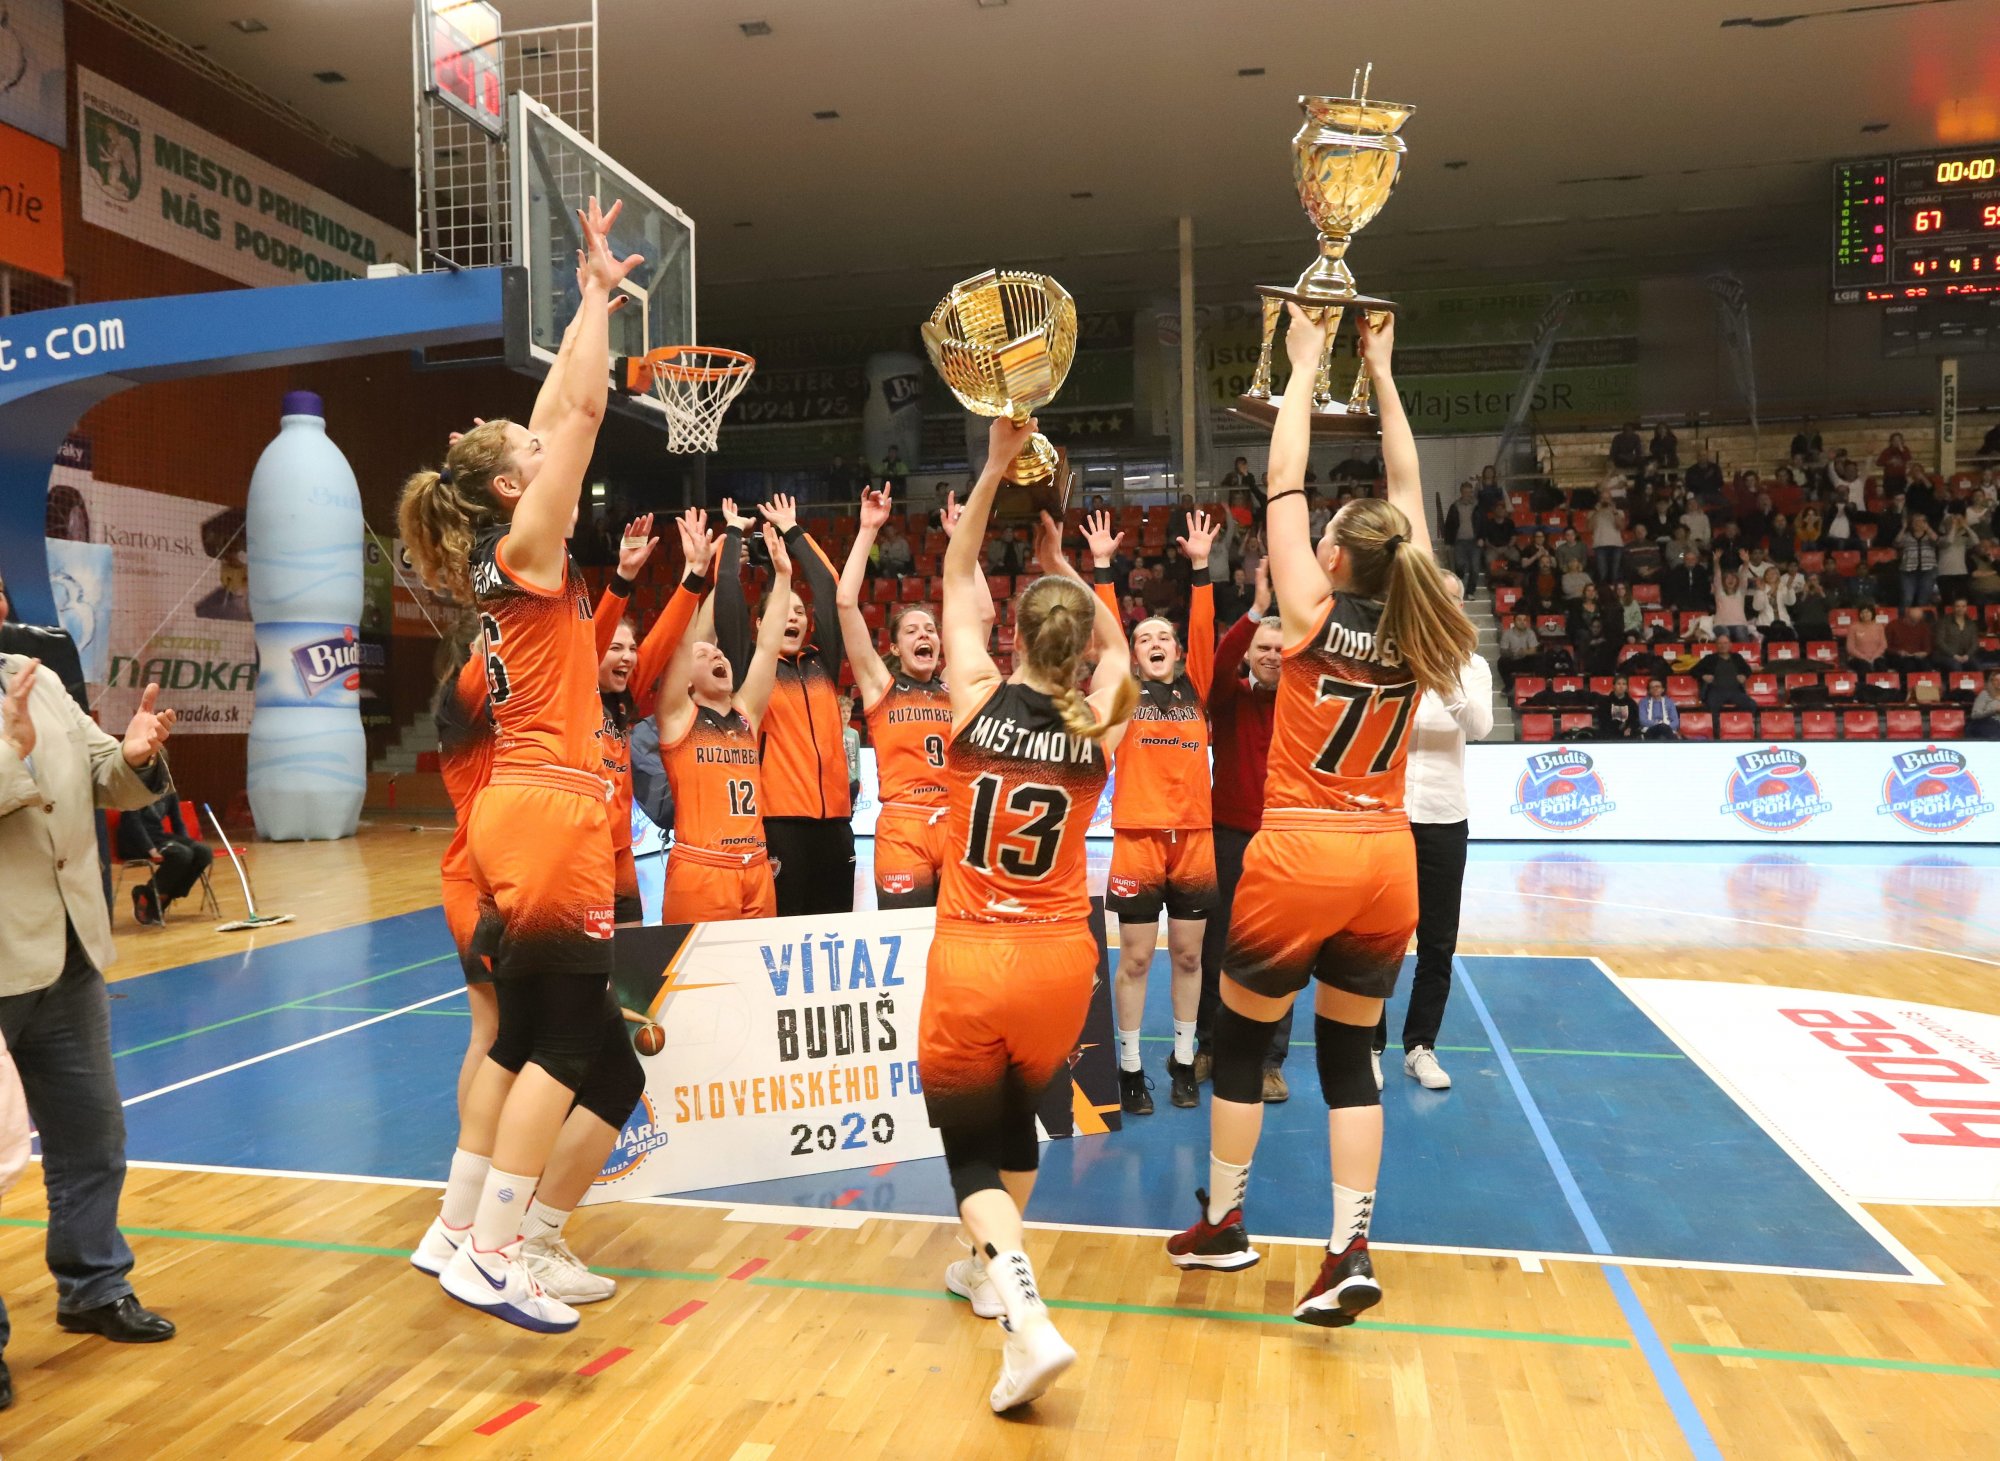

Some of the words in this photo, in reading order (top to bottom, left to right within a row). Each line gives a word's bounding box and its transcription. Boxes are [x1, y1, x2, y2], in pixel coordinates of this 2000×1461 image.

[154, 134, 252, 207] MESTO
[259, 185, 378, 265] PRIEVIDZA
[161, 185, 221, 241] NÁS
[1916, 210, 1941, 231] 67
[1835, 291, 1859, 300] LGR
[1398, 388, 1516, 422] Majster
[1310, 674, 1417, 776] 77
[924, 735, 945, 768] 9
[1142, 737, 1179, 745] mondi
[1181, 742, 1199, 751] scp
[726, 779, 757, 817] 12
[1541, 794, 1603, 817] POHÁR
[1581, 802, 1616, 816] 2020
[1752, 794, 1819, 818] POHÁR
[1795, 802, 1832, 817] 2020
[1910, 794, 1980, 819] POHÁR
[1956, 803, 1994, 818] 2020
[960, 772, 1072, 881] 13
[884, 874, 911, 883] TAURIS
[1112, 875, 1137, 887] TAURIS
[760, 932, 904, 996] VÍŤAZ
[777, 992, 898, 1062] BUDIŠ
[674, 1064, 879, 1123] SLOVENSKÉHO
[890, 1060, 922, 1097] PO
[627, 1133, 668, 1158] 2020
[790, 1112, 895, 1156] 2020
